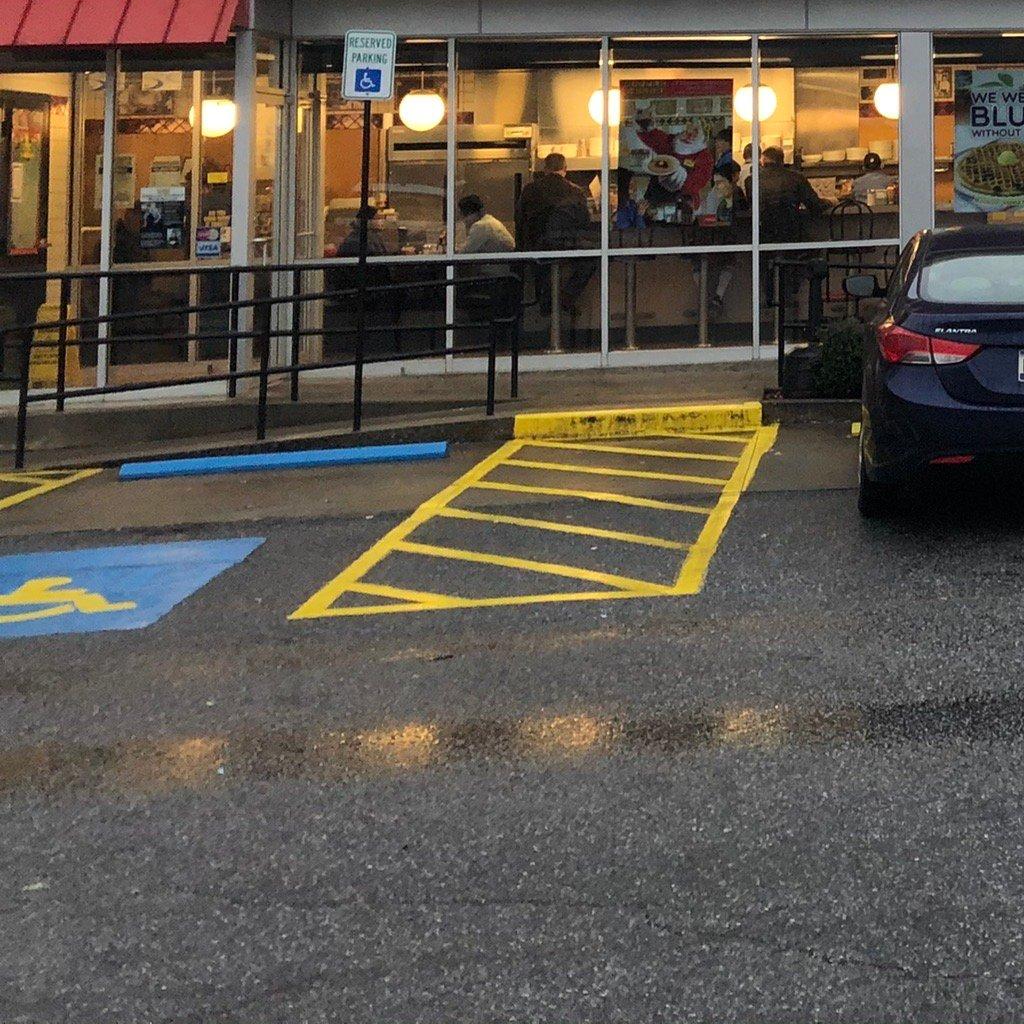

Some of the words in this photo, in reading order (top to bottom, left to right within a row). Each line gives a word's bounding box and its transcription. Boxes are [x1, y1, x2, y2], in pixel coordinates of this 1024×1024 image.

[348, 37, 392, 49] RESERVED
[351, 52, 388, 64] PARKING
[971, 91, 997, 104] WE
[971, 128, 1021, 137] WITHOUT
